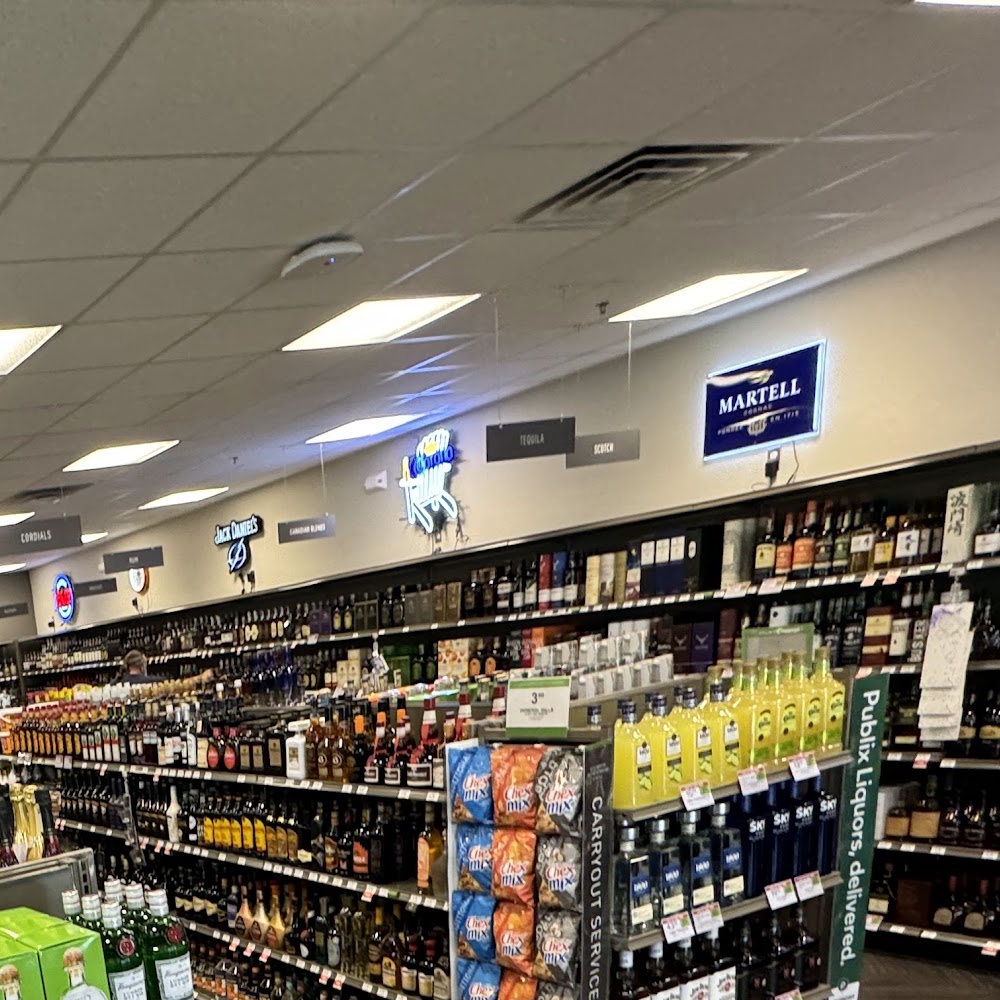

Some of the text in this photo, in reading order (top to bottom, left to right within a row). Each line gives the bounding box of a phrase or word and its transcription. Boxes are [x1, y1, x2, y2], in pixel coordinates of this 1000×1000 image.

[719, 378, 801, 415] MARTELL
[520, 433, 545, 446] TEQUILA
[594, 442, 614, 455] SCOTCH
[21, 530, 52, 544] CORDIALS
[215, 525, 231, 545] JACK
[857, 689, 881, 764] Publix
[463, 774, 490, 789] Chex
[464, 788, 488, 801] mix
[504, 785, 533, 801] Chex
[546, 787, 574, 802] Chex
[507, 800, 530, 813] mix
[546, 800, 572, 814] mix
[848, 767, 874, 857] Liquors,
[590, 797, 603, 908] CARRYOUT
[501, 861, 526, 876] Chex
[546, 864, 573, 880] Chex
[502, 875, 525, 886] mix
[549, 877, 572, 890] mix
[840, 863, 864, 967] delivered.
[466, 916, 490, 931] Chex
[467, 929, 489, 941] mix
[501, 932, 525, 947] Chex
[502, 945, 522, 957] mix
[542, 938, 569, 954] Chex
[544, 952, 566, 966] mix
[469, 983, 494, 998] Chex
